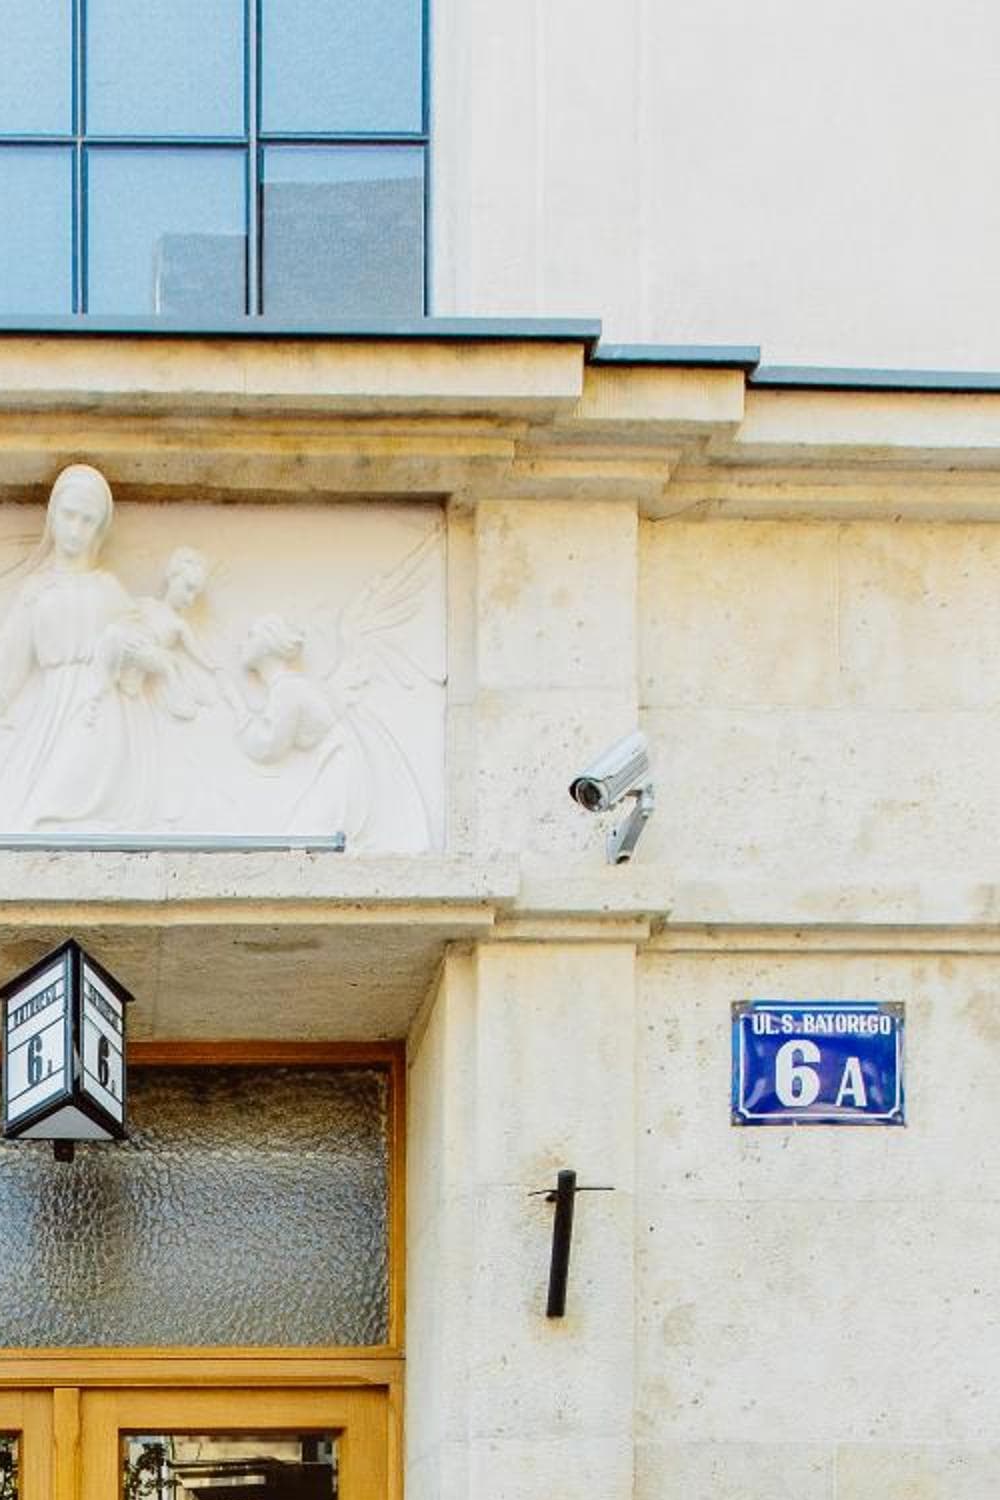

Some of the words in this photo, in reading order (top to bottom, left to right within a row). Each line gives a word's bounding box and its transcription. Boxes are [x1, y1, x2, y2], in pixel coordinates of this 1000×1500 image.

[752, 1013, 779, 1035] UL.
[803, 1013, 891, 1035] BATOREGO
[775, 1039, 821, 1107] 6
[836, 1056, 867, 1107] A
